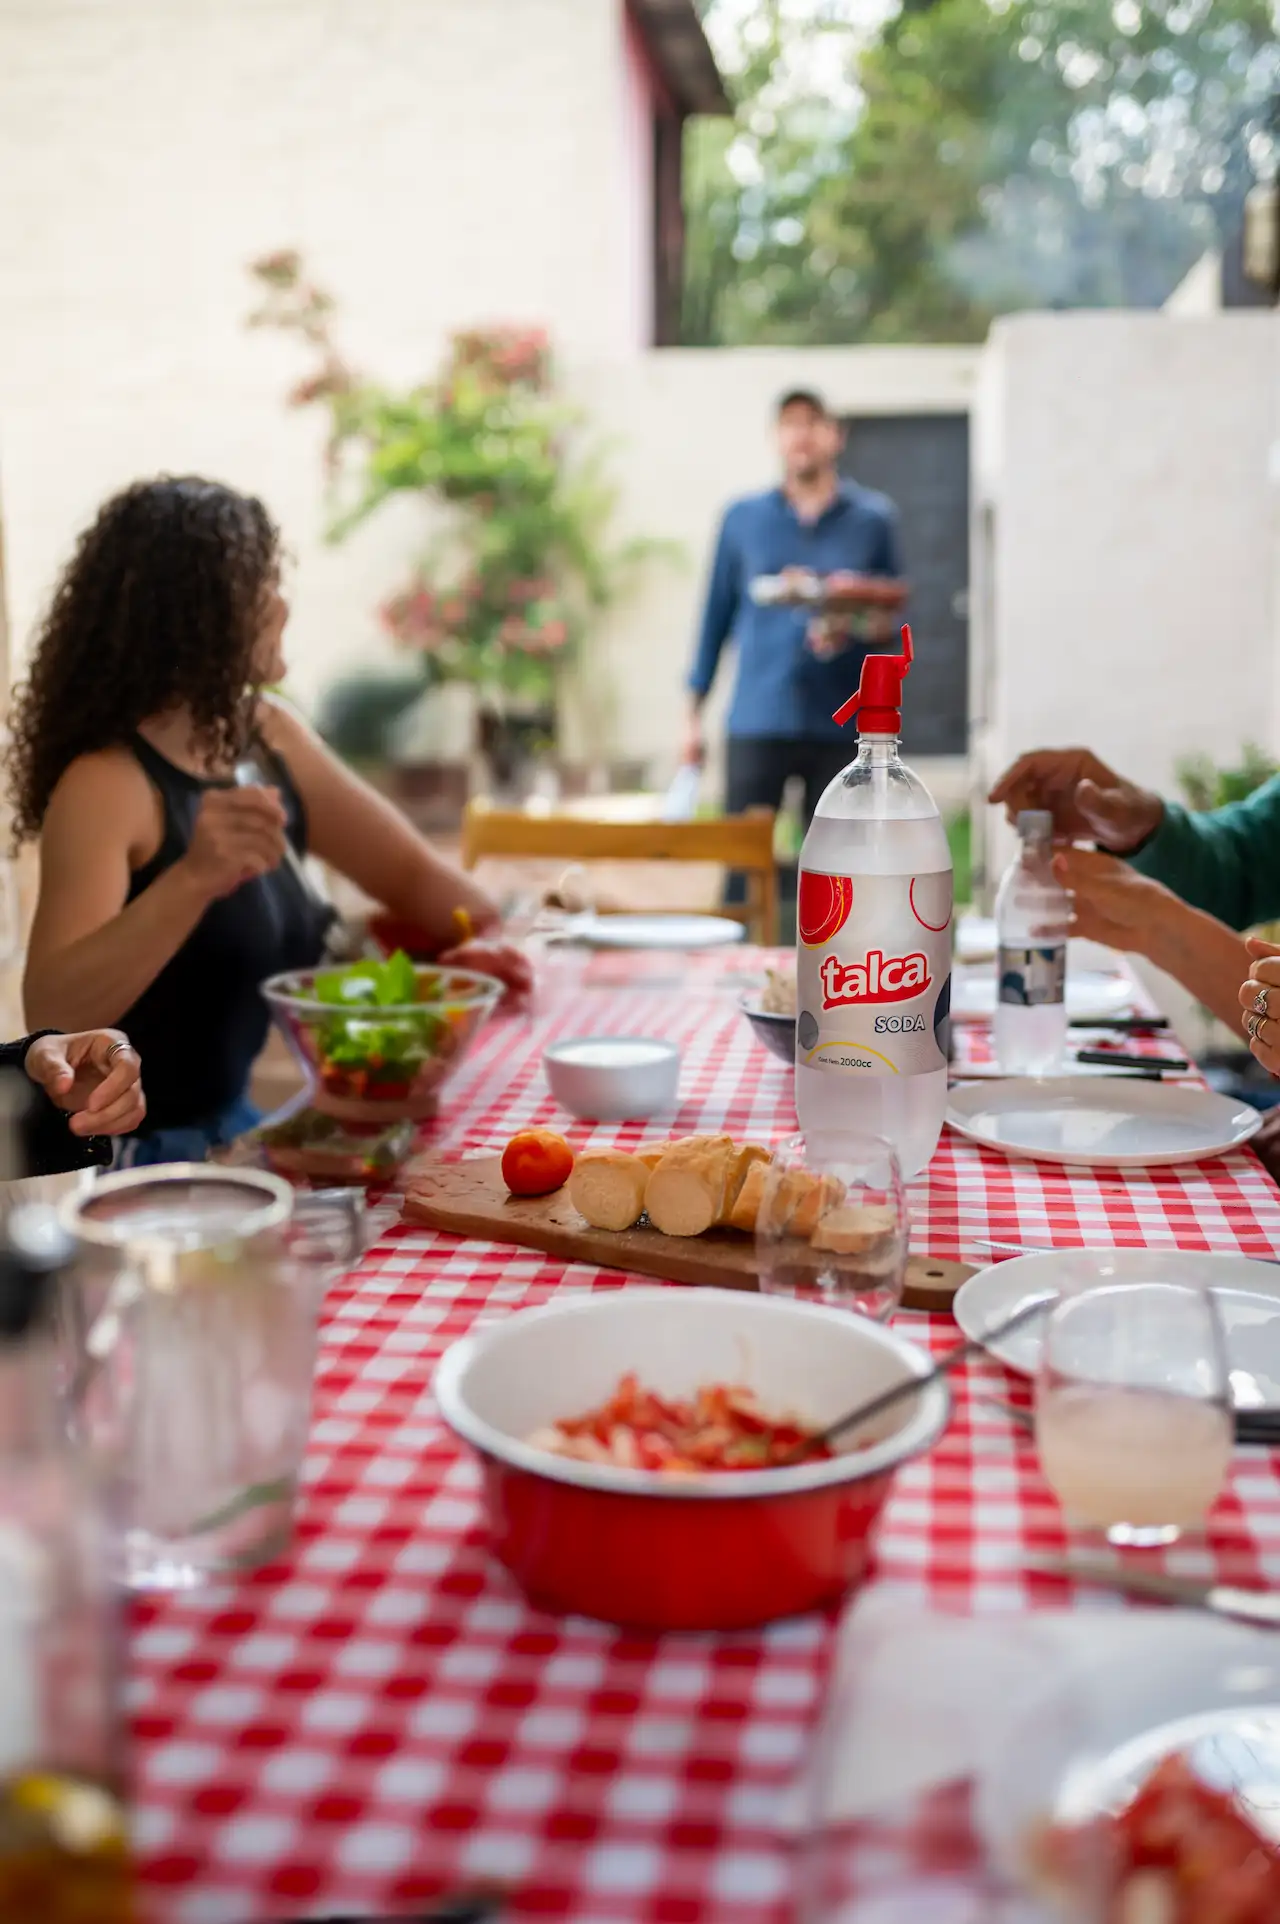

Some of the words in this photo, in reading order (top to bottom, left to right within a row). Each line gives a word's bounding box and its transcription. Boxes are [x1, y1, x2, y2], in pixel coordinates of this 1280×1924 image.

[821, 951, 928, 1001] talca
[875, 1015, 925, 1033] SODA
[840, 1057, 872, 1067] 2000cc
